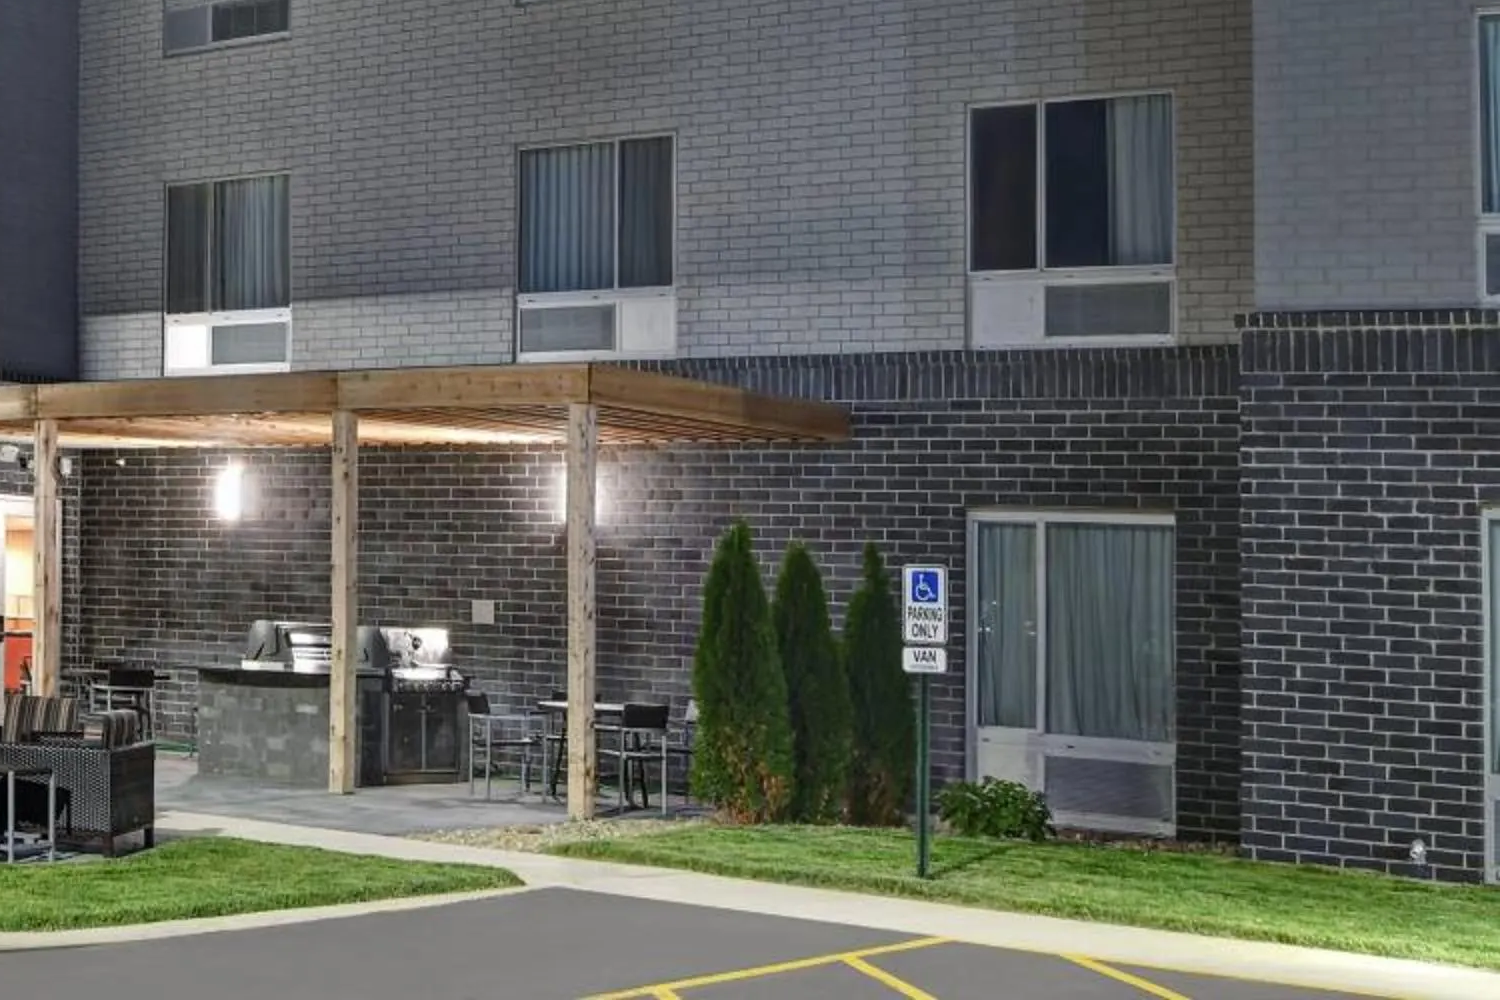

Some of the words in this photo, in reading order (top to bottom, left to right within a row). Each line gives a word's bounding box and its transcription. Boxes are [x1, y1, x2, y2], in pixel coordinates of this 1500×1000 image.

[907, 606, 943, 622] PARKING
[911, 623, 939, 639] ONLY
[913, 650, 937, 663] VAN
